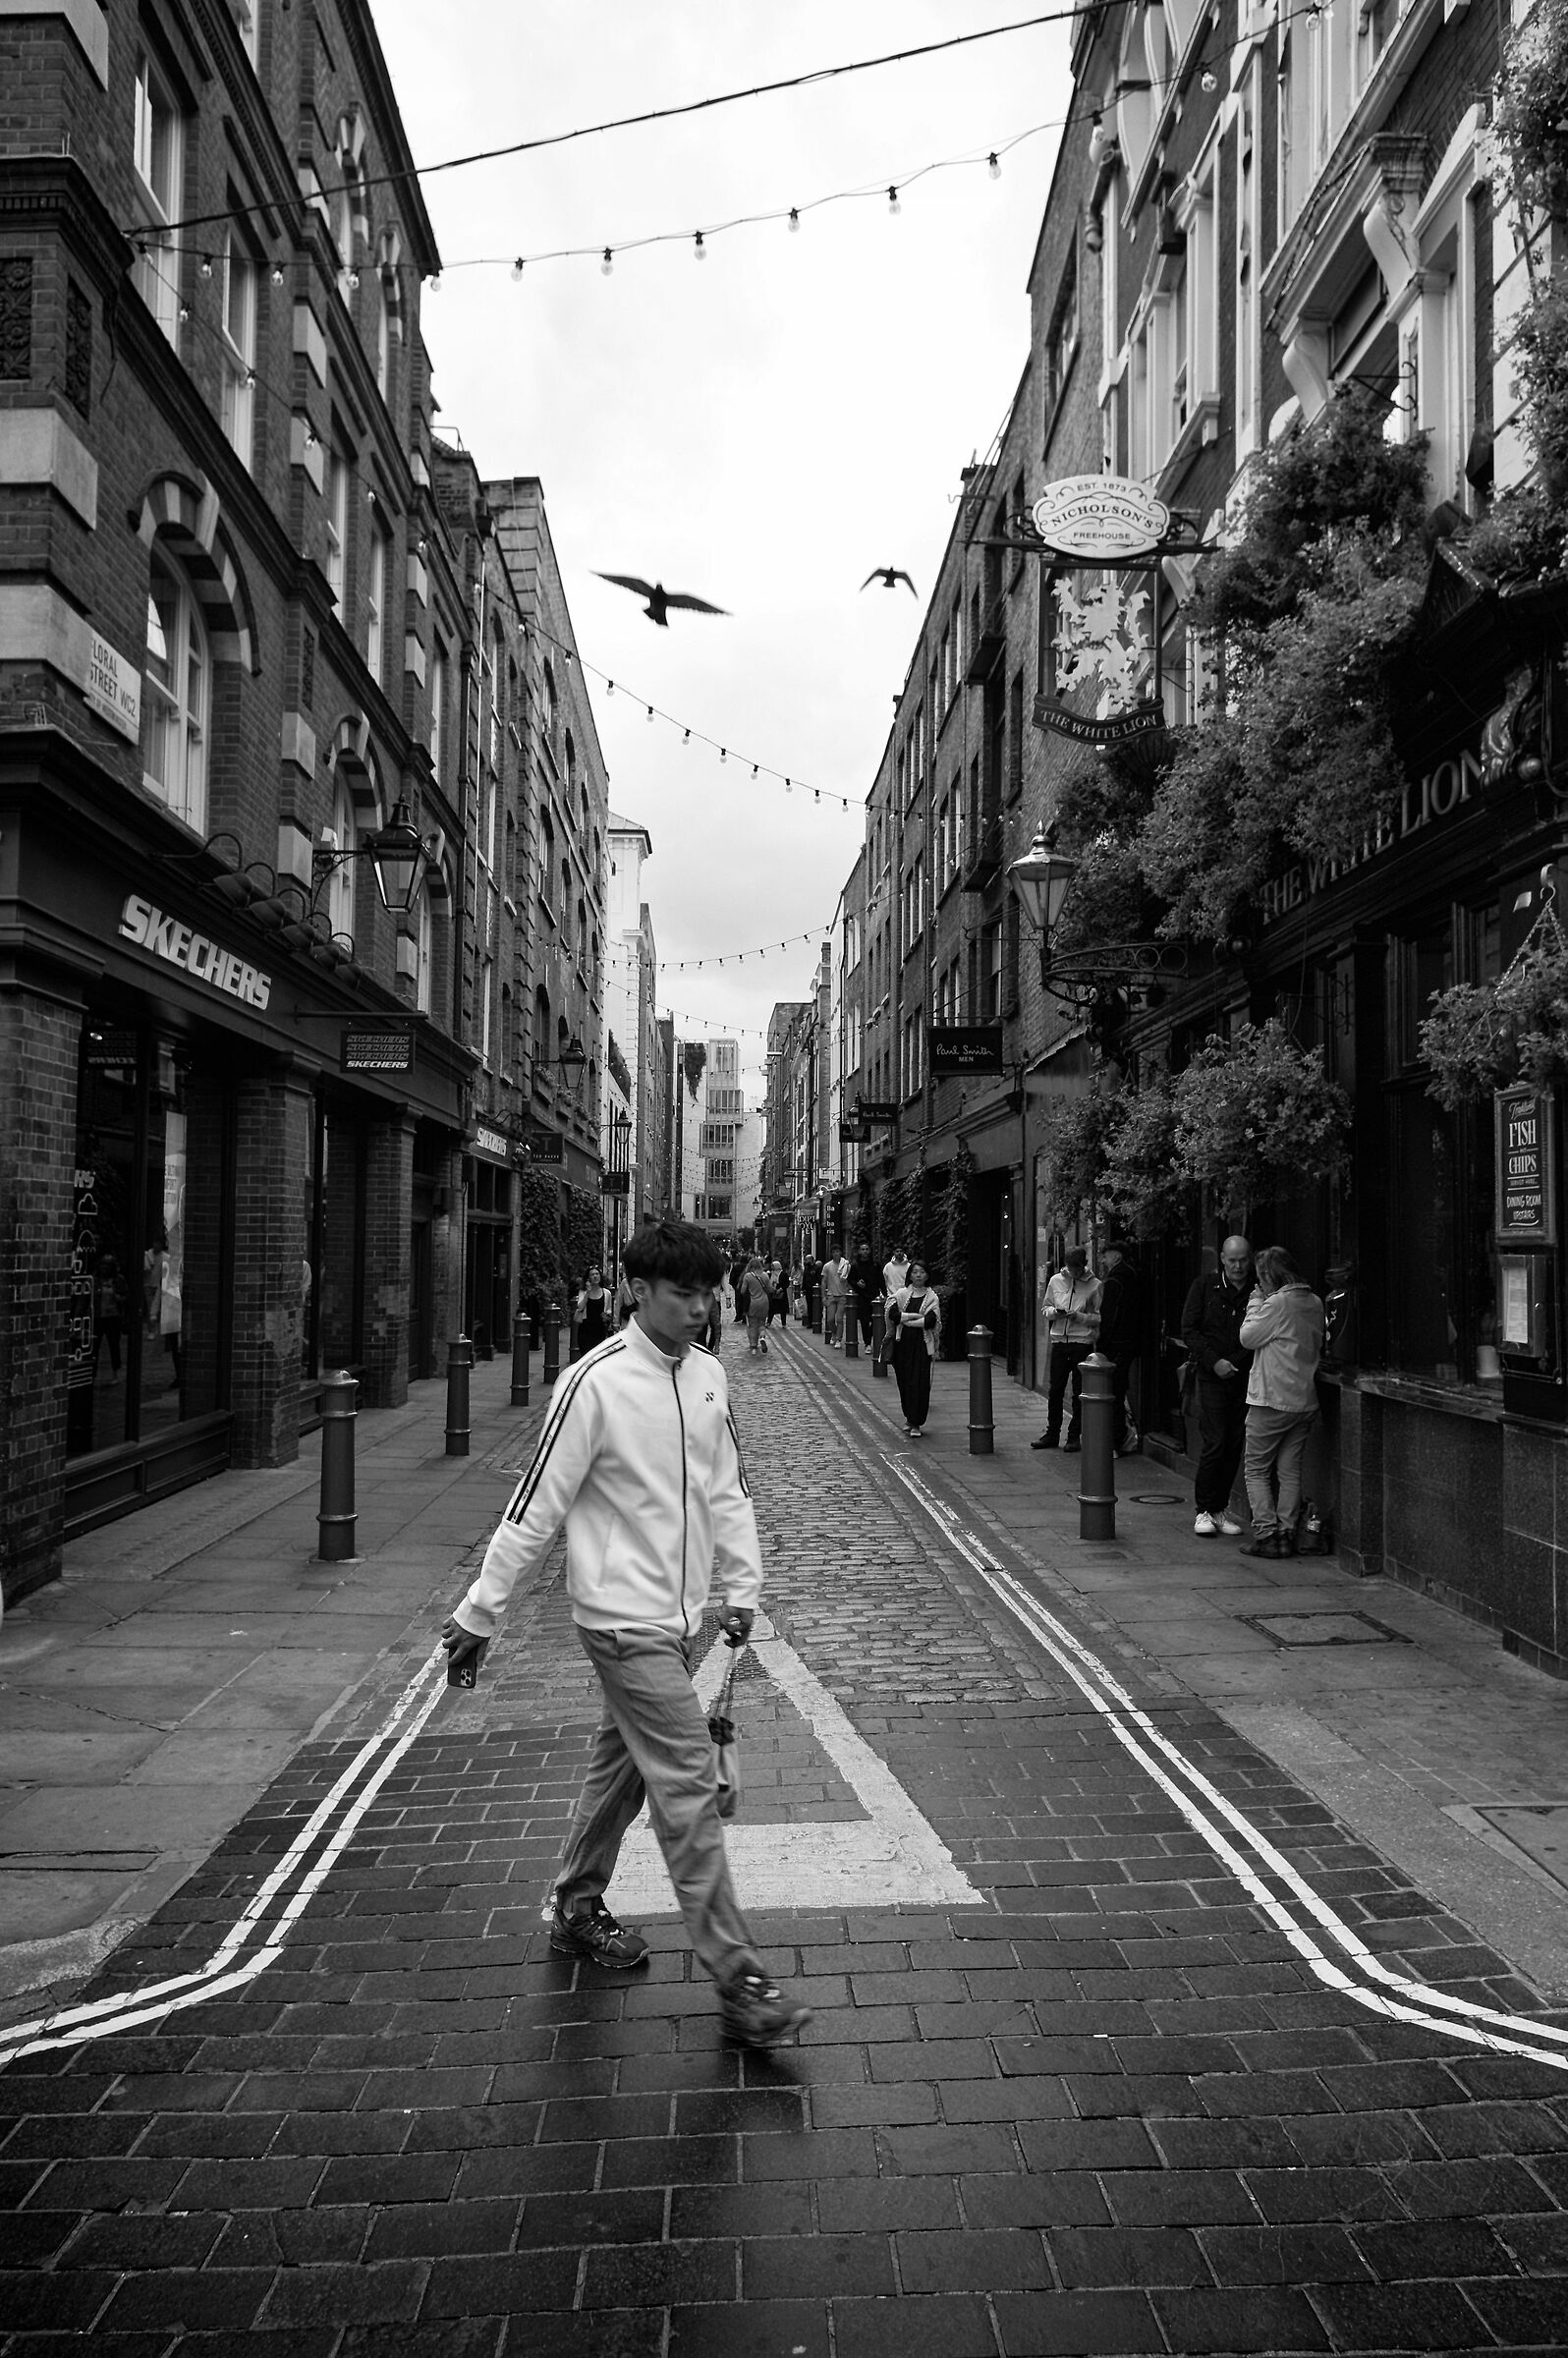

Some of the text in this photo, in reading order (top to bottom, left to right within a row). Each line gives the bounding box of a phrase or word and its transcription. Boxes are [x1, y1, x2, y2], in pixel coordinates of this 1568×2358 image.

[1077, 482, 1127, 492] EST. 1873
[1051, 504, 1153, 529] NICHOLSON'S
[92, 640, 118, 678] LORAL
[120, 687, 137, 718] WC2
[1041, 710, 1157, 739] THE WHITE LION
[1260, 748, 1483, 926] THE LION
[118, 894, 272, 1011] SKECHERS
[936, 1043, 994, 1056] Paul Smith
[346, 1060, 409, 1069] SKECHERS
[1508, 1119, 1537, 1148] FISH
[1508, 1153, 1537, 1174] CHIPS
